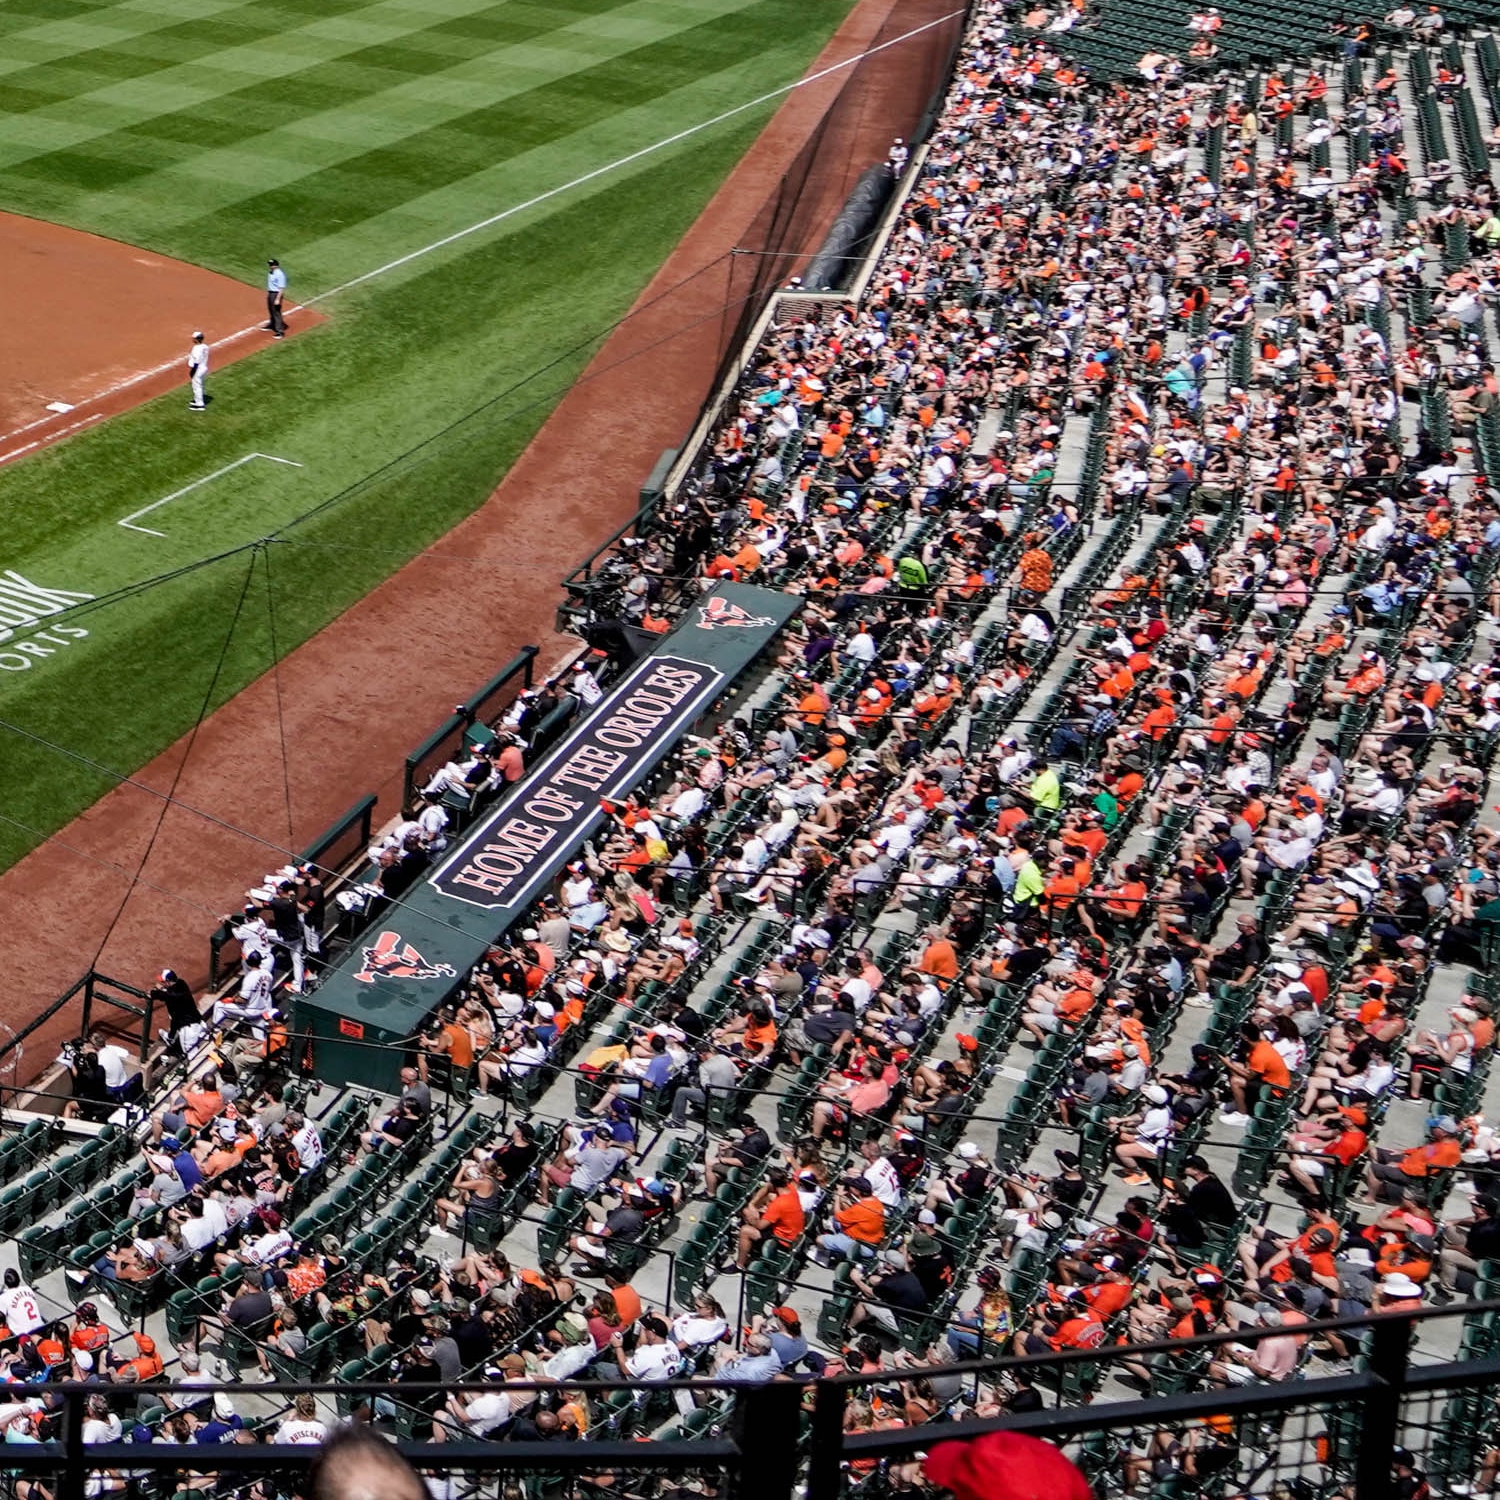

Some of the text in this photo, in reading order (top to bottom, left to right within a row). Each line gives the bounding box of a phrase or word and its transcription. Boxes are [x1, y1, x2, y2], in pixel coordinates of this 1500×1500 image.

[453, 664, 703, 896] HOME OF THE ORIOLES
[23, 1301, 37, 1320] 2
